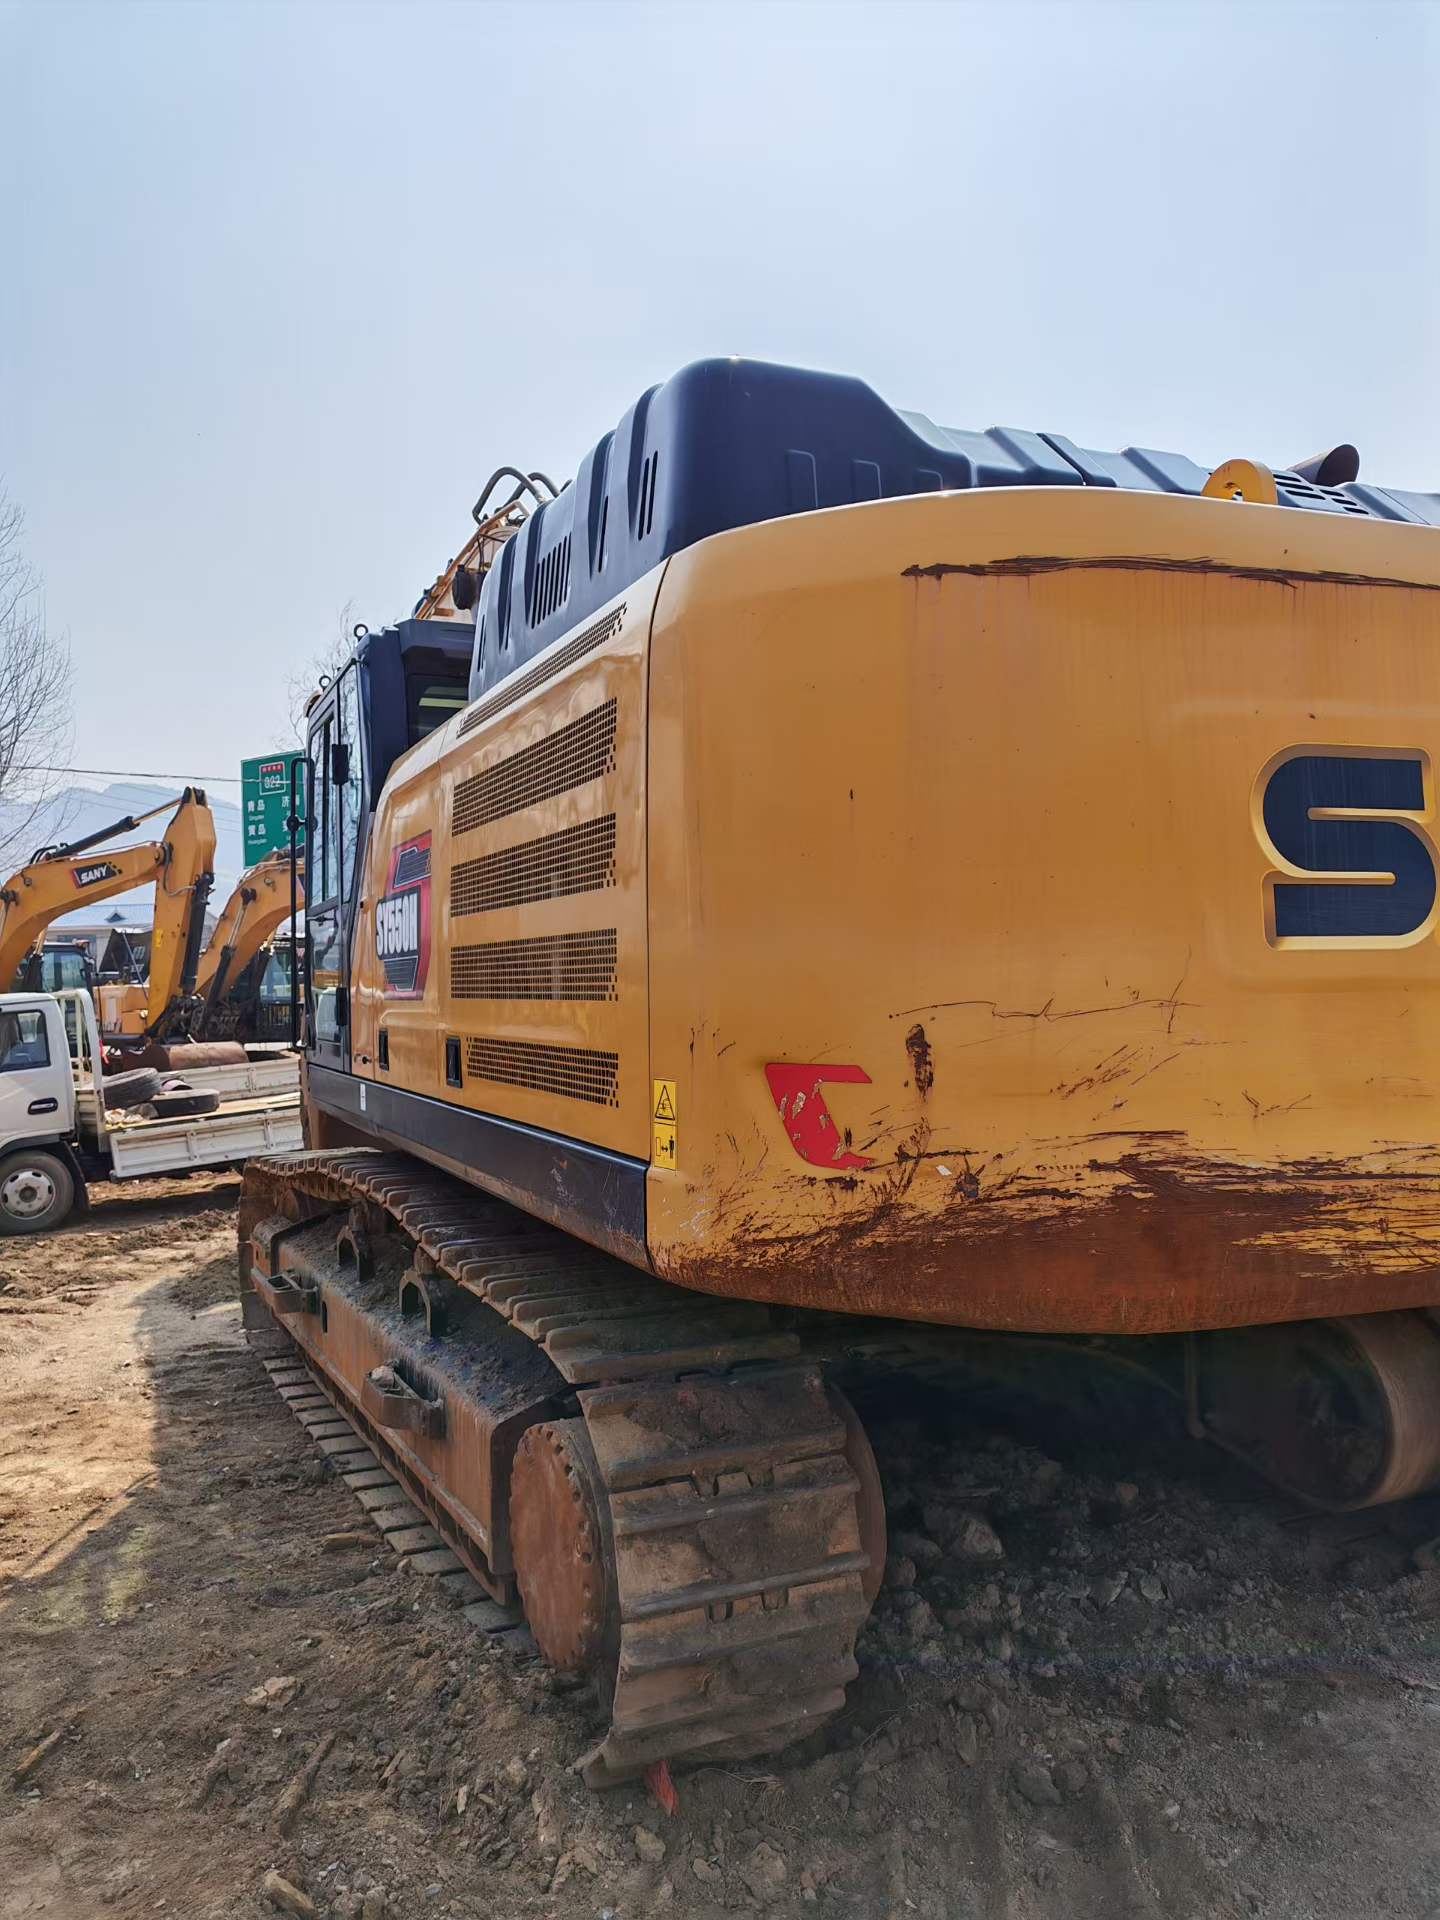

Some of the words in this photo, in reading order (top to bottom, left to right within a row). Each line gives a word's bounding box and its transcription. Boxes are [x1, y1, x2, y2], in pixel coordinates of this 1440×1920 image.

[81, 865, 107, 884] SANY
[1257, 750, 1437, 942] S
[376, 893, 418, 956] SY550H
